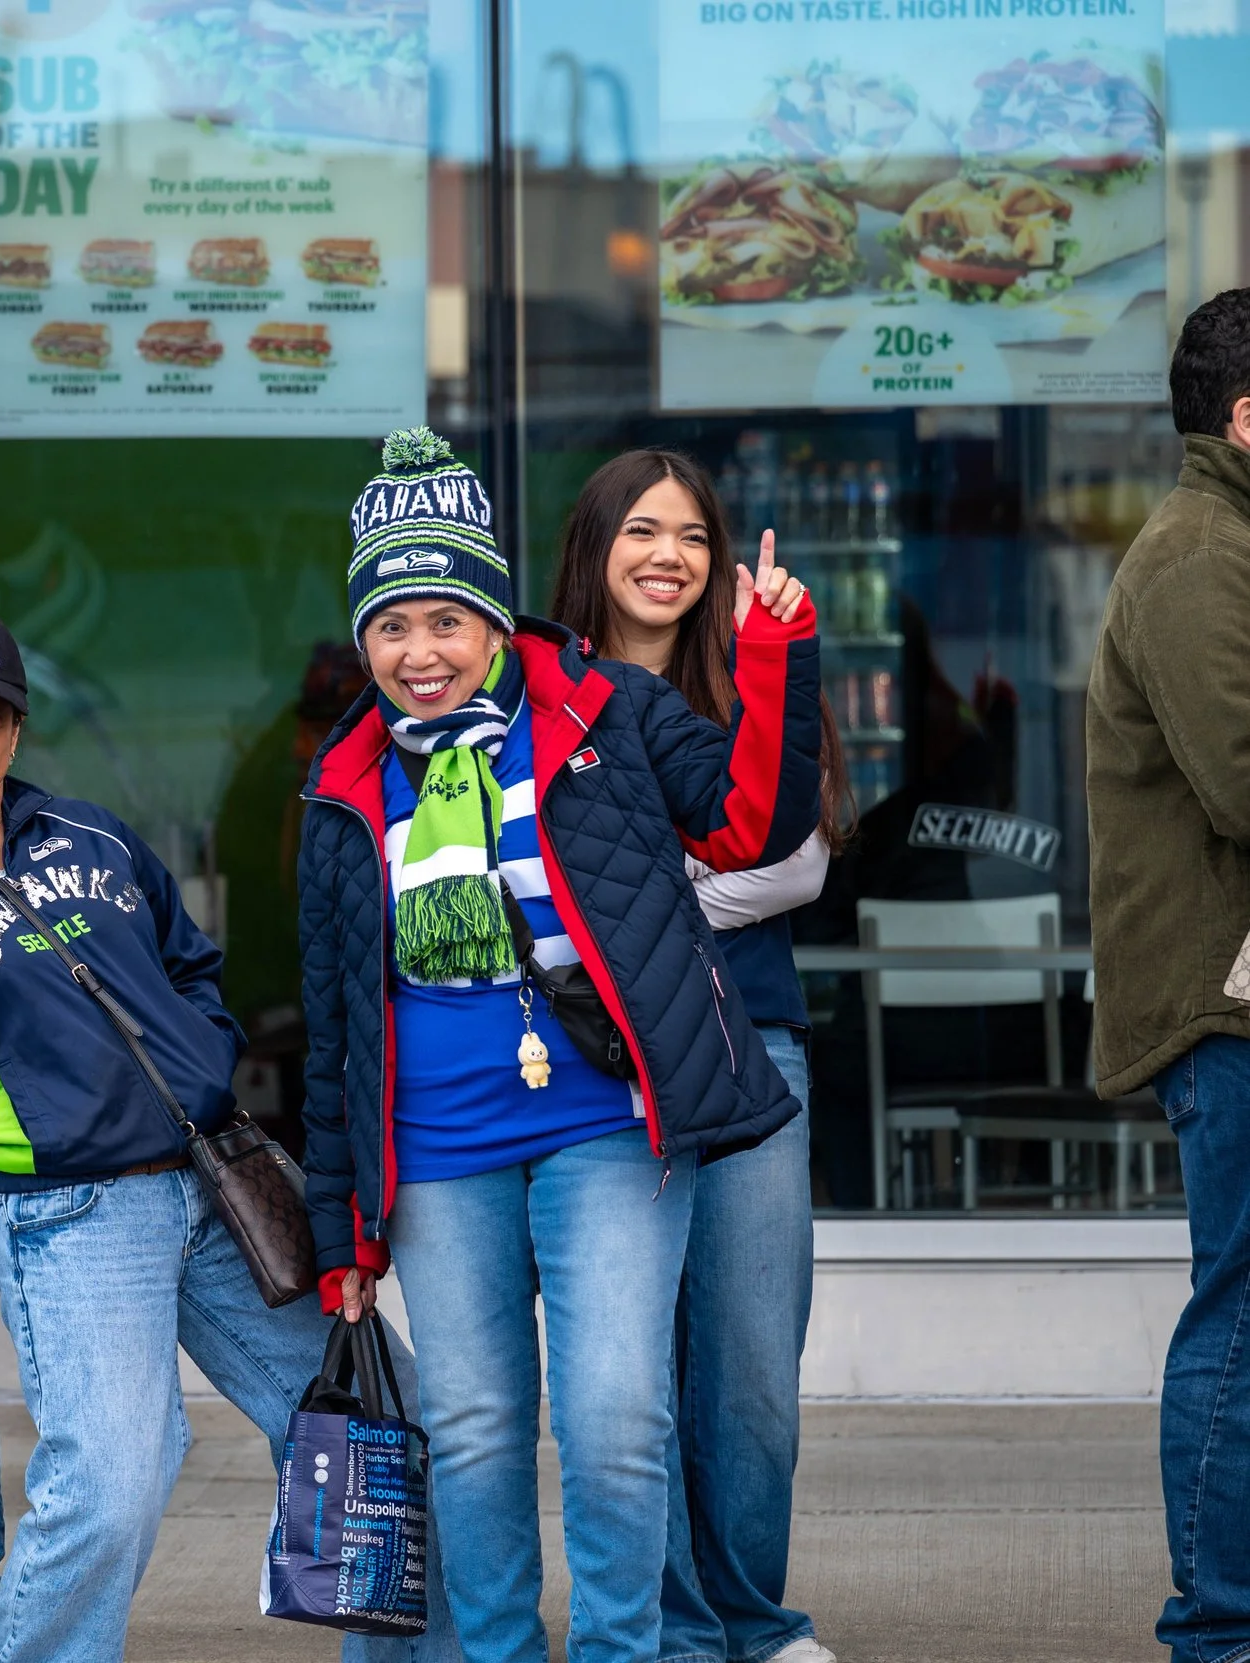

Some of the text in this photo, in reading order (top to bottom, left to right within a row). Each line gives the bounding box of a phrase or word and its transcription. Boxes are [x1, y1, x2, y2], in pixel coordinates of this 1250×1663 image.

[701, 0, 1134, 24] BIG ON TASTE. HIGH IN PROTEIN.
[34, 121, 99, 149] THE
[149, 178, 176, 196] Try
[180, 181, 191, 193] a
[194, 177, 272, 193] different
[297, 178, 331, 193] sub
[143, 198, 335, 217] every day of the week
[91, 303, 147, 313] TUESDAY
[188, 302, 268, 313] WEDNESDAY
[307, 302, 376, 313] THURSDAY
[902, 362, 922, 375] OF
[52, 385, 97, 395] FRIDAY
[147, 385, 213, 395] SATURDAY
[266, 385, 318, 395] SUNDAY
[873, 377, 953, 391] PROTEIN
[351, 478, 492, 542] SEAHAWKS
[916, 808, 1052, 865] SECURITY
[347, 1420, 406, 1445] Salmon
[365, 1452, 390, 1464] Harbor
[345, 1442, 356, 1497] Salmonberry
[357, 1442, 368, 1497] GONDOLA
[366, 1463, 390, 1476] Crabby
[367, 1474, 390, 1486] Bloody
[344, 1499, 406, 1520] Unspoiled
[343, 1517, 393, 1532] Authentic
[342, 1532, 384, 1547] Muskeg
[393, 1518, 401, 1556] Skunk
[383, 1534, 393, 1568] Crab
[335, 1546, 356, 1605] Breach
[351, 1546, 367, 1607] HISTORIC
[363, 1547, 377, 1609] CANNERY
